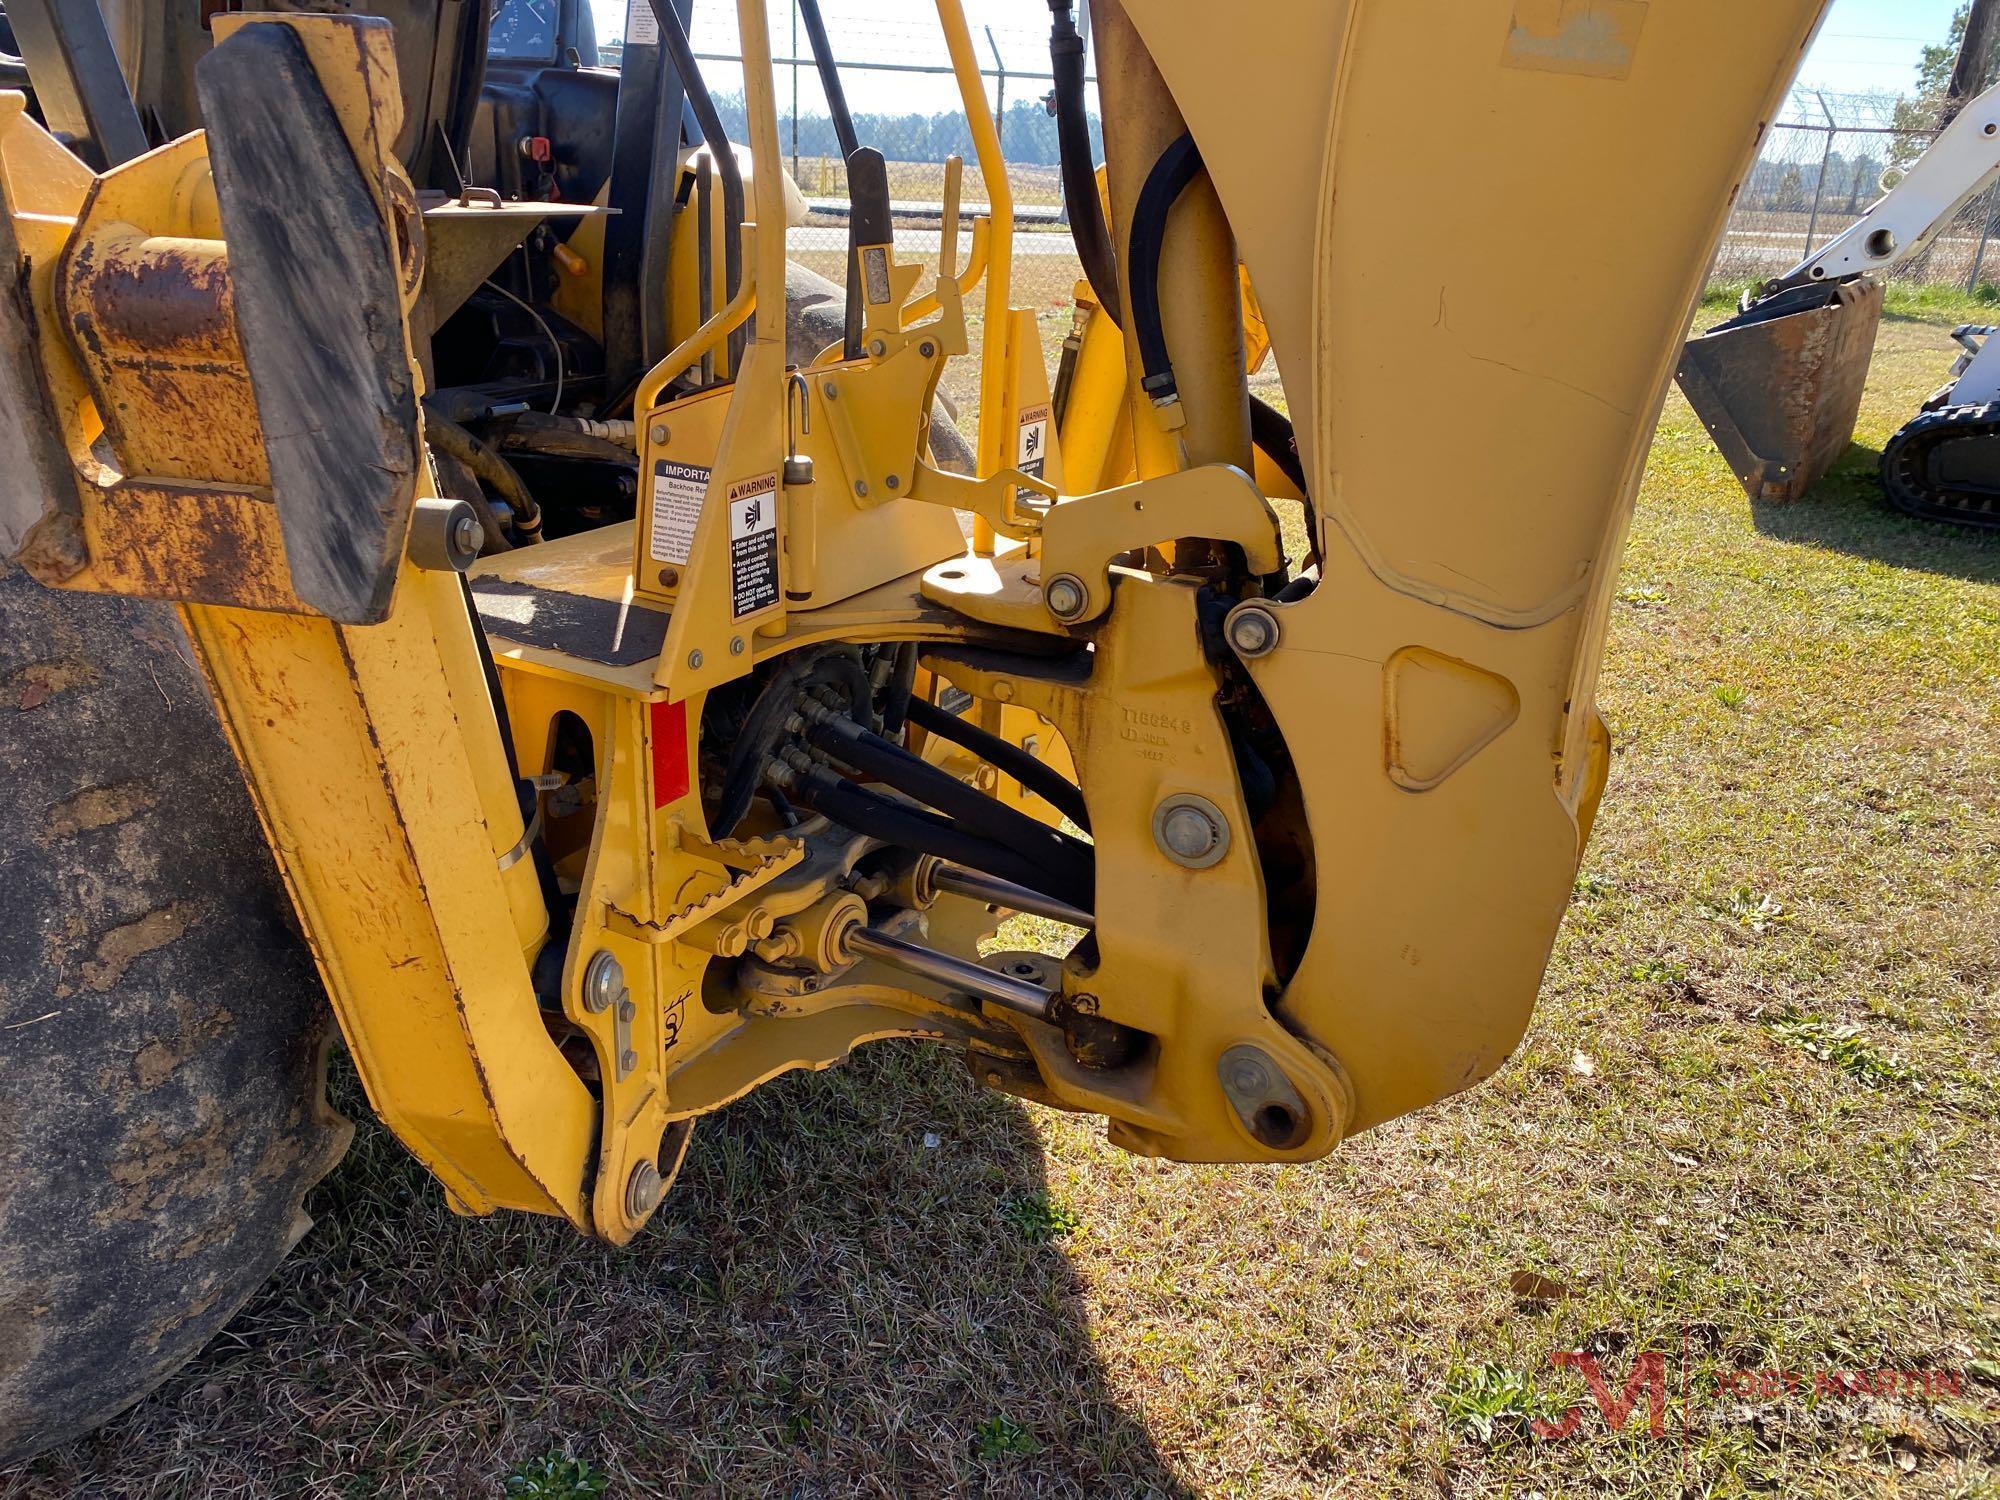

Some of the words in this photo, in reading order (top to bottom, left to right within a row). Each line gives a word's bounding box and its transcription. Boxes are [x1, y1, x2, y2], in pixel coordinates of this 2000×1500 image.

[1025, 408, 1048, 421] WARNING
[668, 481, 694, 492] Backhoe
[738, 476, 776, 497] WARNING
[736, 541, 748, 550] Enter
[748, 536, 757, 545] and
[757, 534, 765, 543] exit
[766, 531, 775, 540] only
[736, 548, 748, 557] from
[748, 544, 757, 553] this
[757, 541, 769, 550] side.
[737, 557, 750, 568] Avoid
[751, 552, 769, 563] contact
[737, 566, 748, 576] with
[748, 560, 767, 572] controls
[737, 573, 750, 583] when
[751, 567, 770, 578] entering
[737, 581, 747, 590] and
[737, 591, 746, 600] DO
[745, 587, 756, 597] NOT
[756, 583, 772, 594] operate
[738, 595, 756, 607] controls
[756, 591, 767, 600] from
[767, 588, 775, 596] the
